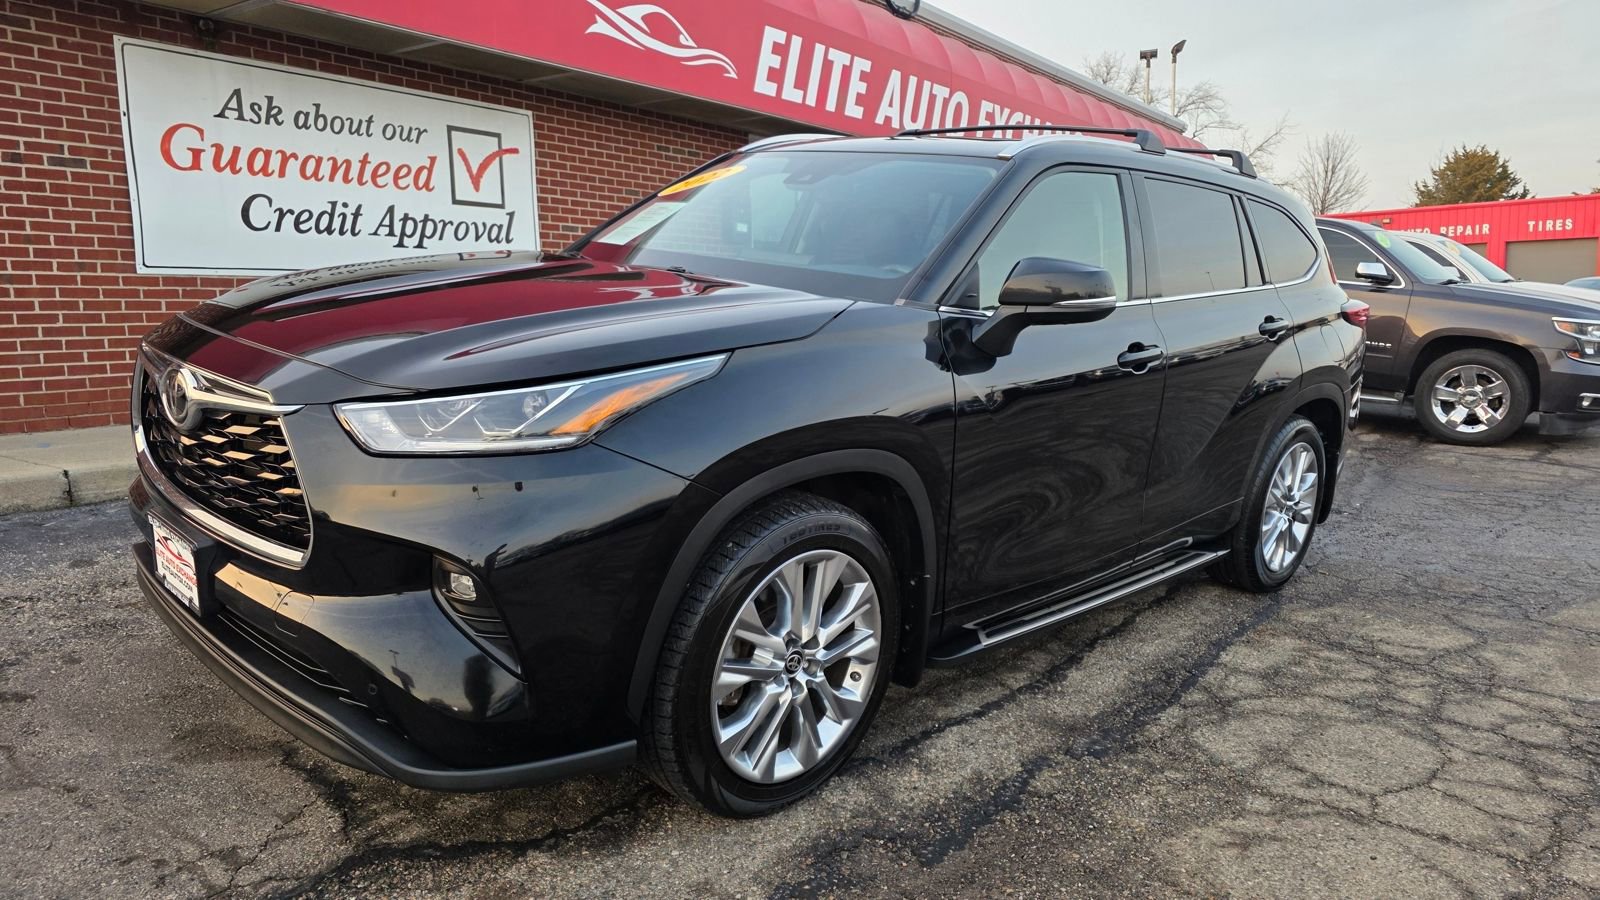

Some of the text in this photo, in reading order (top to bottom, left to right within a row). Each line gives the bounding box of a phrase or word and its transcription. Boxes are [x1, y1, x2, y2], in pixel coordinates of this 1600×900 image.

[753, 25, 872, 119] ELITE
[874, 68, 970, 138] AUTO
[213, 87, 429, 145] Ask about our
[159, 122, 438, 193] Guaranteed
[240, 193, 516, 250] Credit Approval
[1440, 223, 1490, 237] REPAIR
[1527, 218, 1574, 233] TIRES
